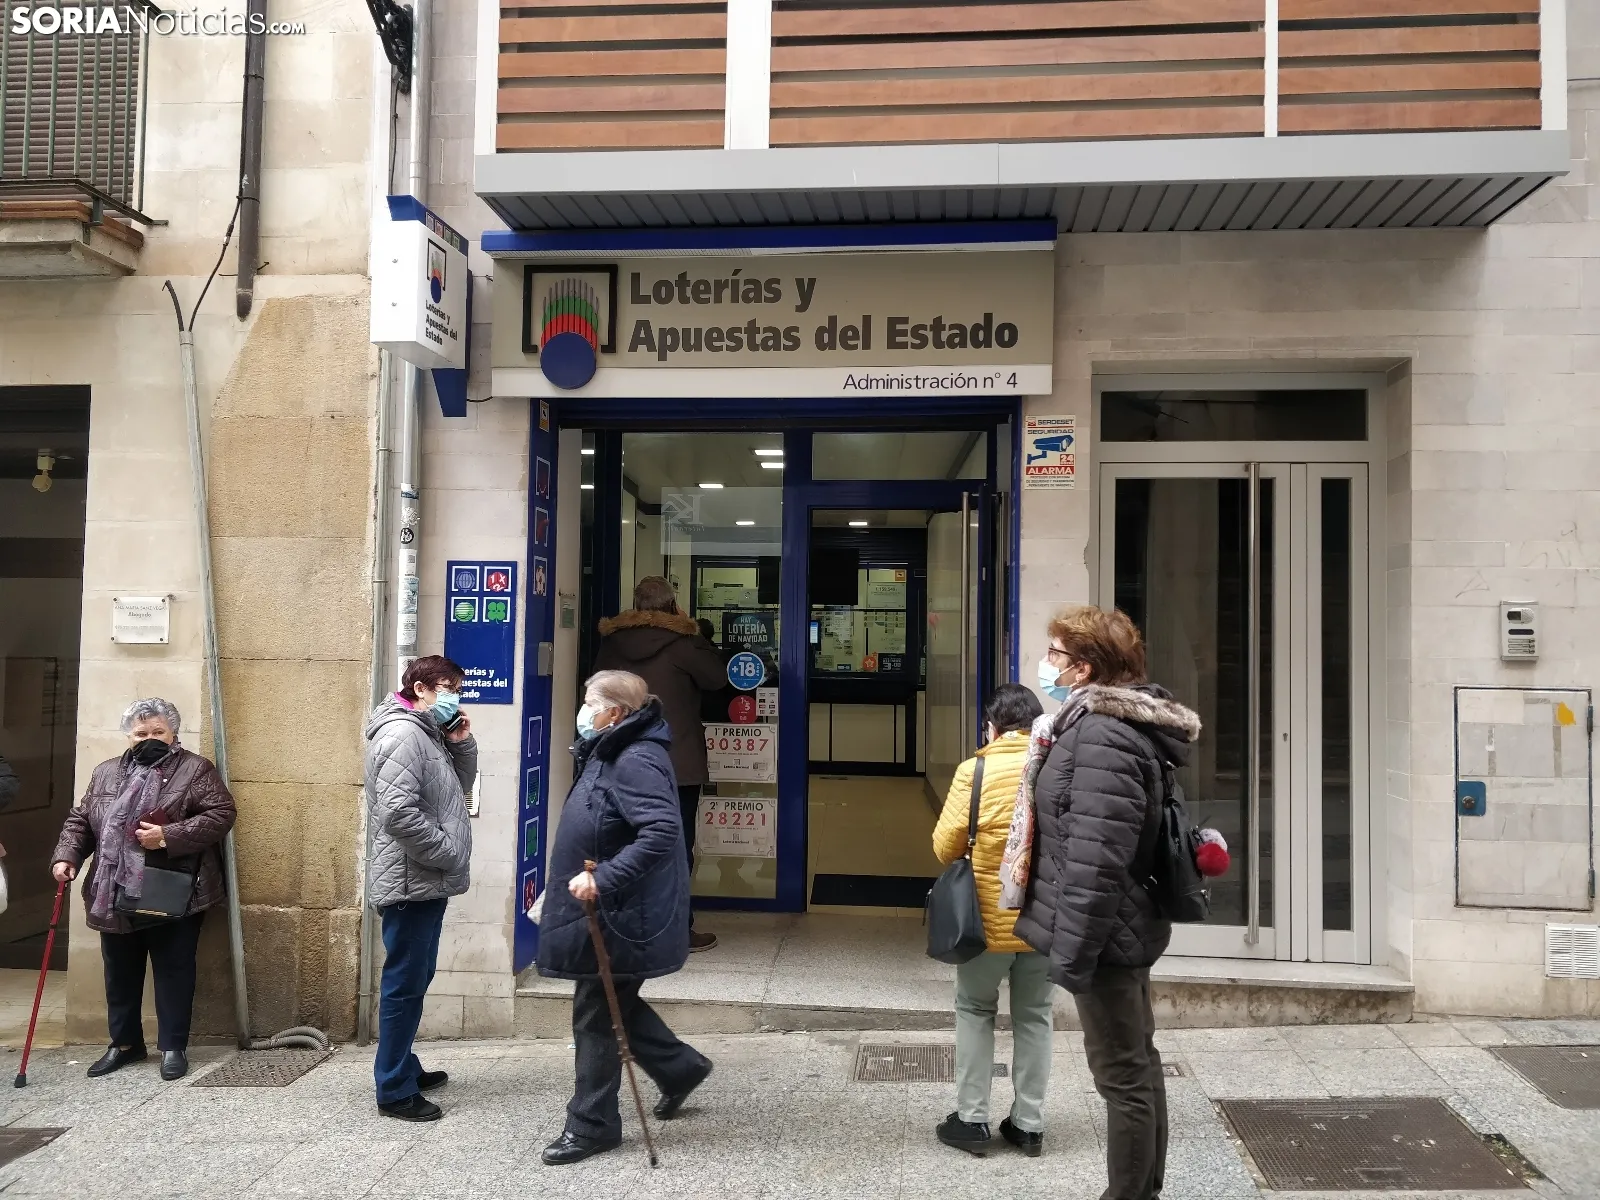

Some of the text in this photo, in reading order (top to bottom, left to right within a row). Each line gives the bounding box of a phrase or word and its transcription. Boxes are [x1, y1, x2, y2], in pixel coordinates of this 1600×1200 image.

[630, 269, 817, 312] Loterías y
[425, 327, 443, 345] Estado
[628, 312, 1019, 361] Apuestas del Estado
[843, 371, 979, 391] Administración
[1005, 372, 1018, 389] 4
[1027, 466, 1073, 475] ALARMA
[740, 616, 752, 624] HAY
[728, 620, 767, 635] LOTERÍA
[728, 634, 768, 643] DE NAVIDAD
[461, 666, 495, 679] erías y
[731, 662, 756, 677] +18
[461, 678, 508, 688] uestas del
[460, 689, 481, 698] ado
[722, 727, 762, 738] PREMIO
[706, 737, 769, 752] 30387
[724, 801, 764, 812] PREMIO
[704, 811, 767, 827] 28221
